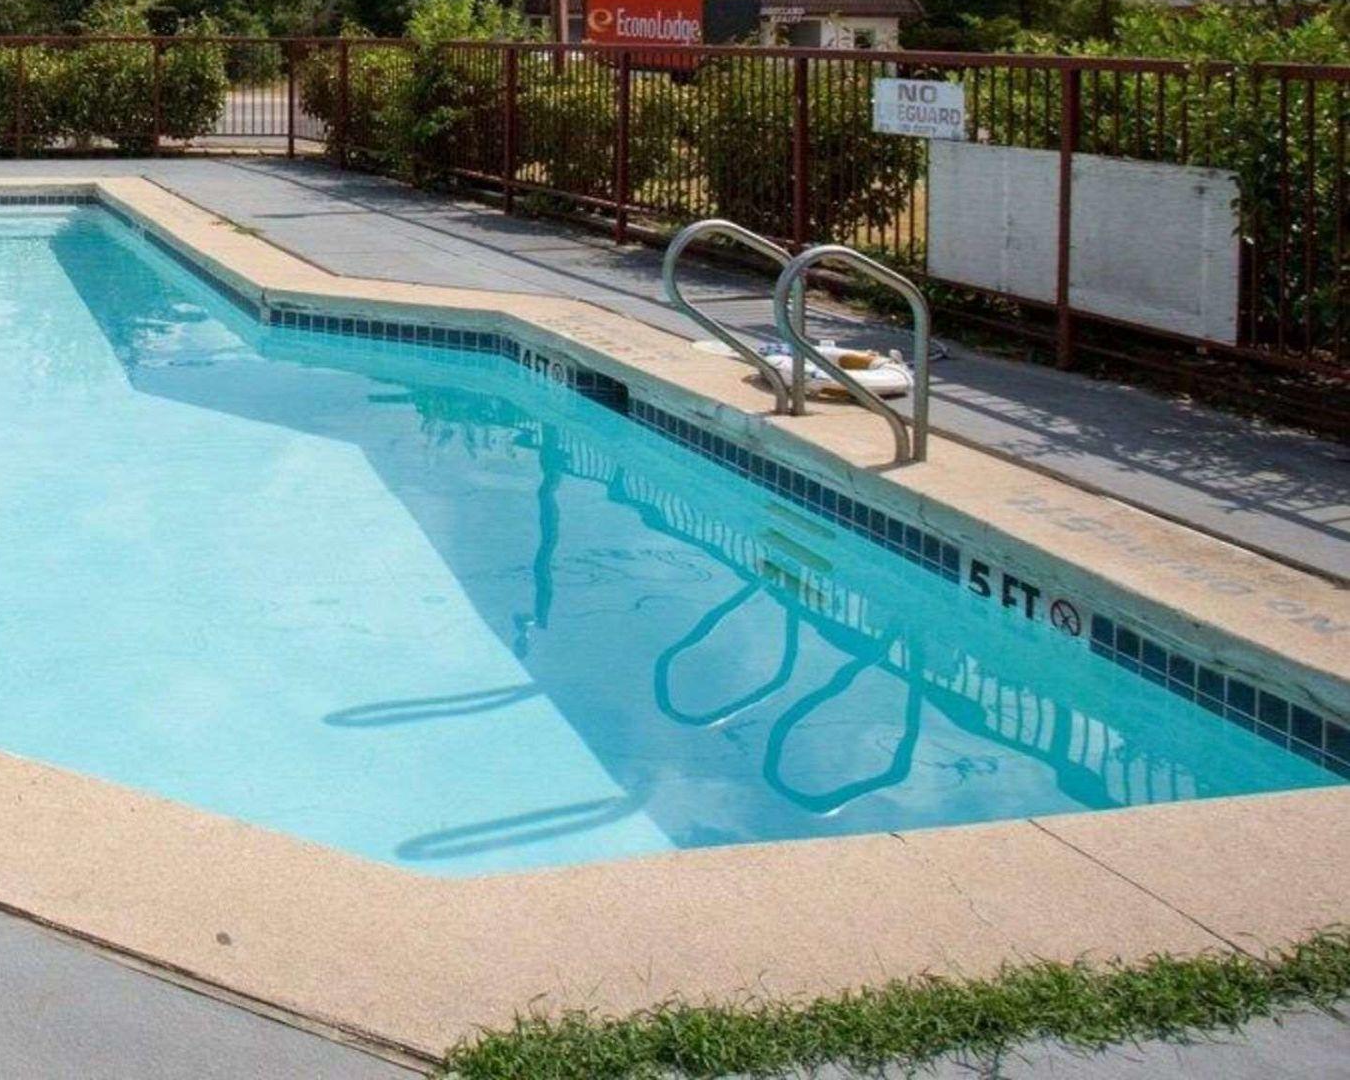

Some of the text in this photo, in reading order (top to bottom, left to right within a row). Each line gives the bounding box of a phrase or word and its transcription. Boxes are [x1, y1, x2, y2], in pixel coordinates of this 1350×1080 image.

[898, 83, 937, 103] NO
[897, 104, 962, 126] EGUARD
[521, 349, 549, 378] 4 FT
[968, 558, 1040, 620] 5 FT
